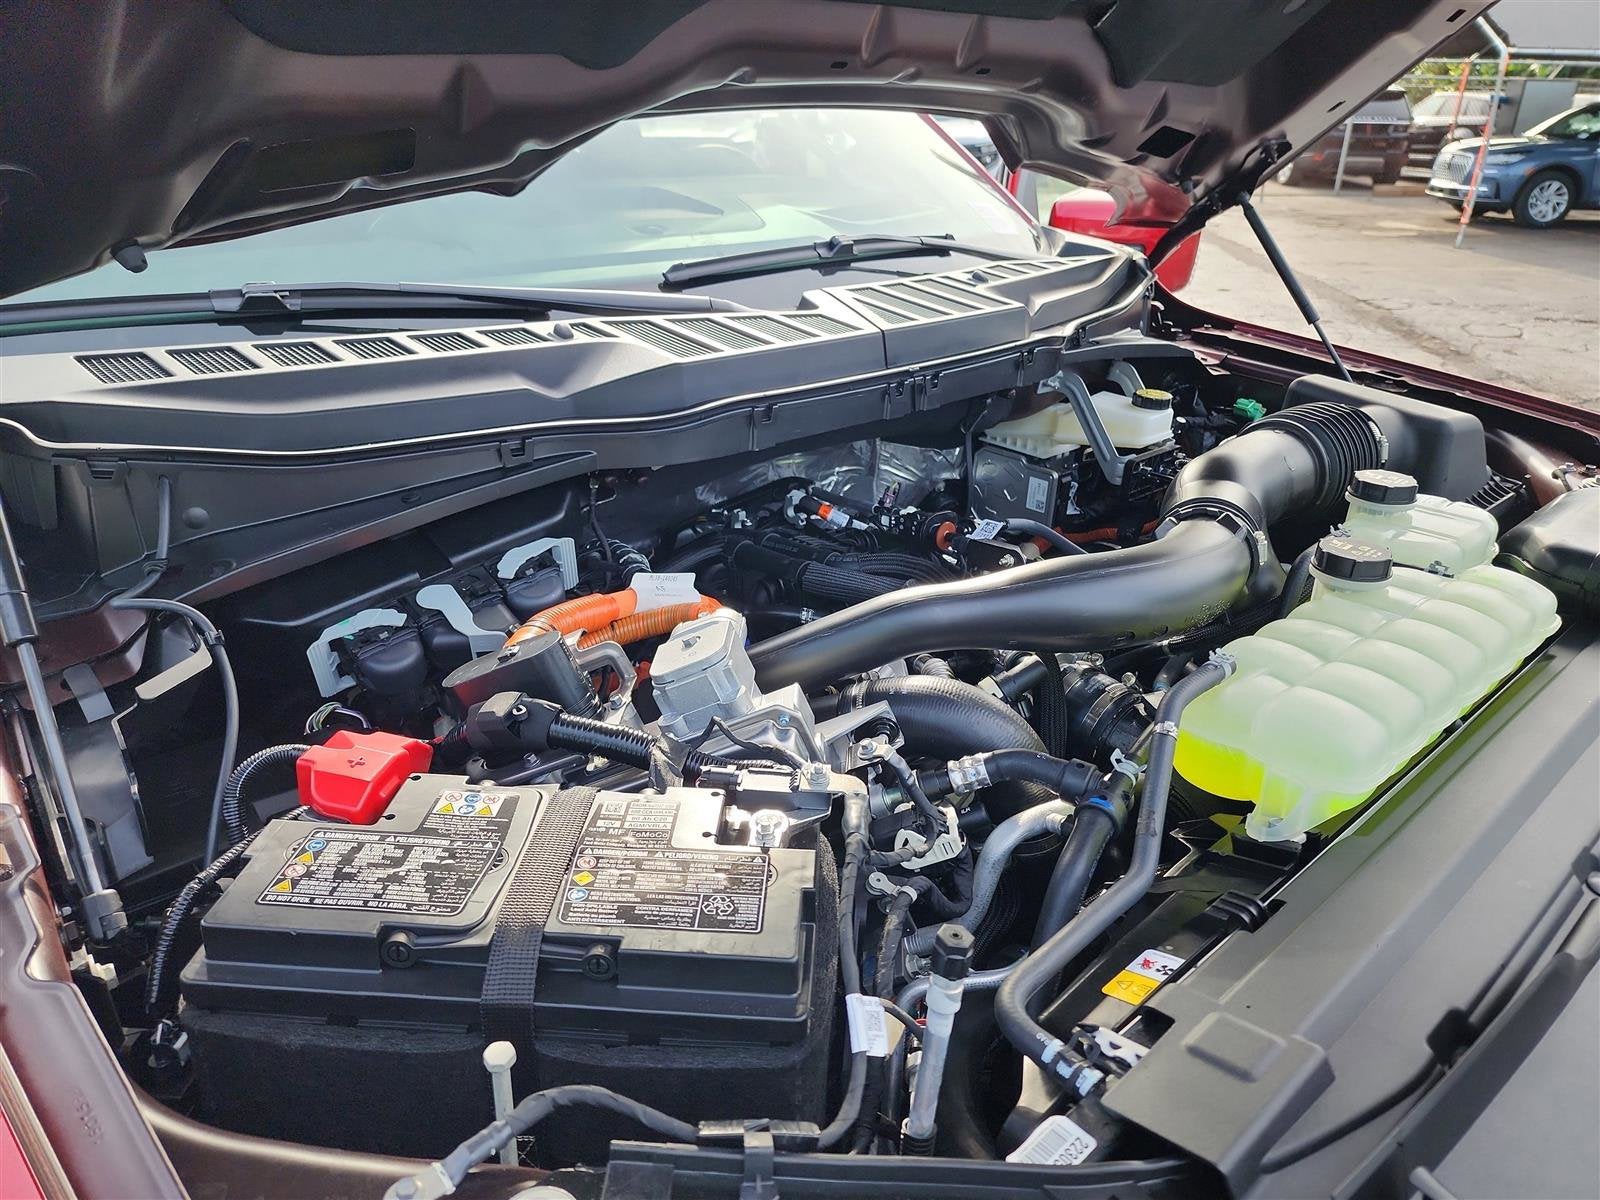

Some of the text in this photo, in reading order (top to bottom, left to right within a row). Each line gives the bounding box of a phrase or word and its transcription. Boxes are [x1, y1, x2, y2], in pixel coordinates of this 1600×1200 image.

[325, 832, 381, 840] DANGER/POISON
[608, 828, 626, 836] MF
[395, 836, 451, 845] PELIGRO/VENENO
